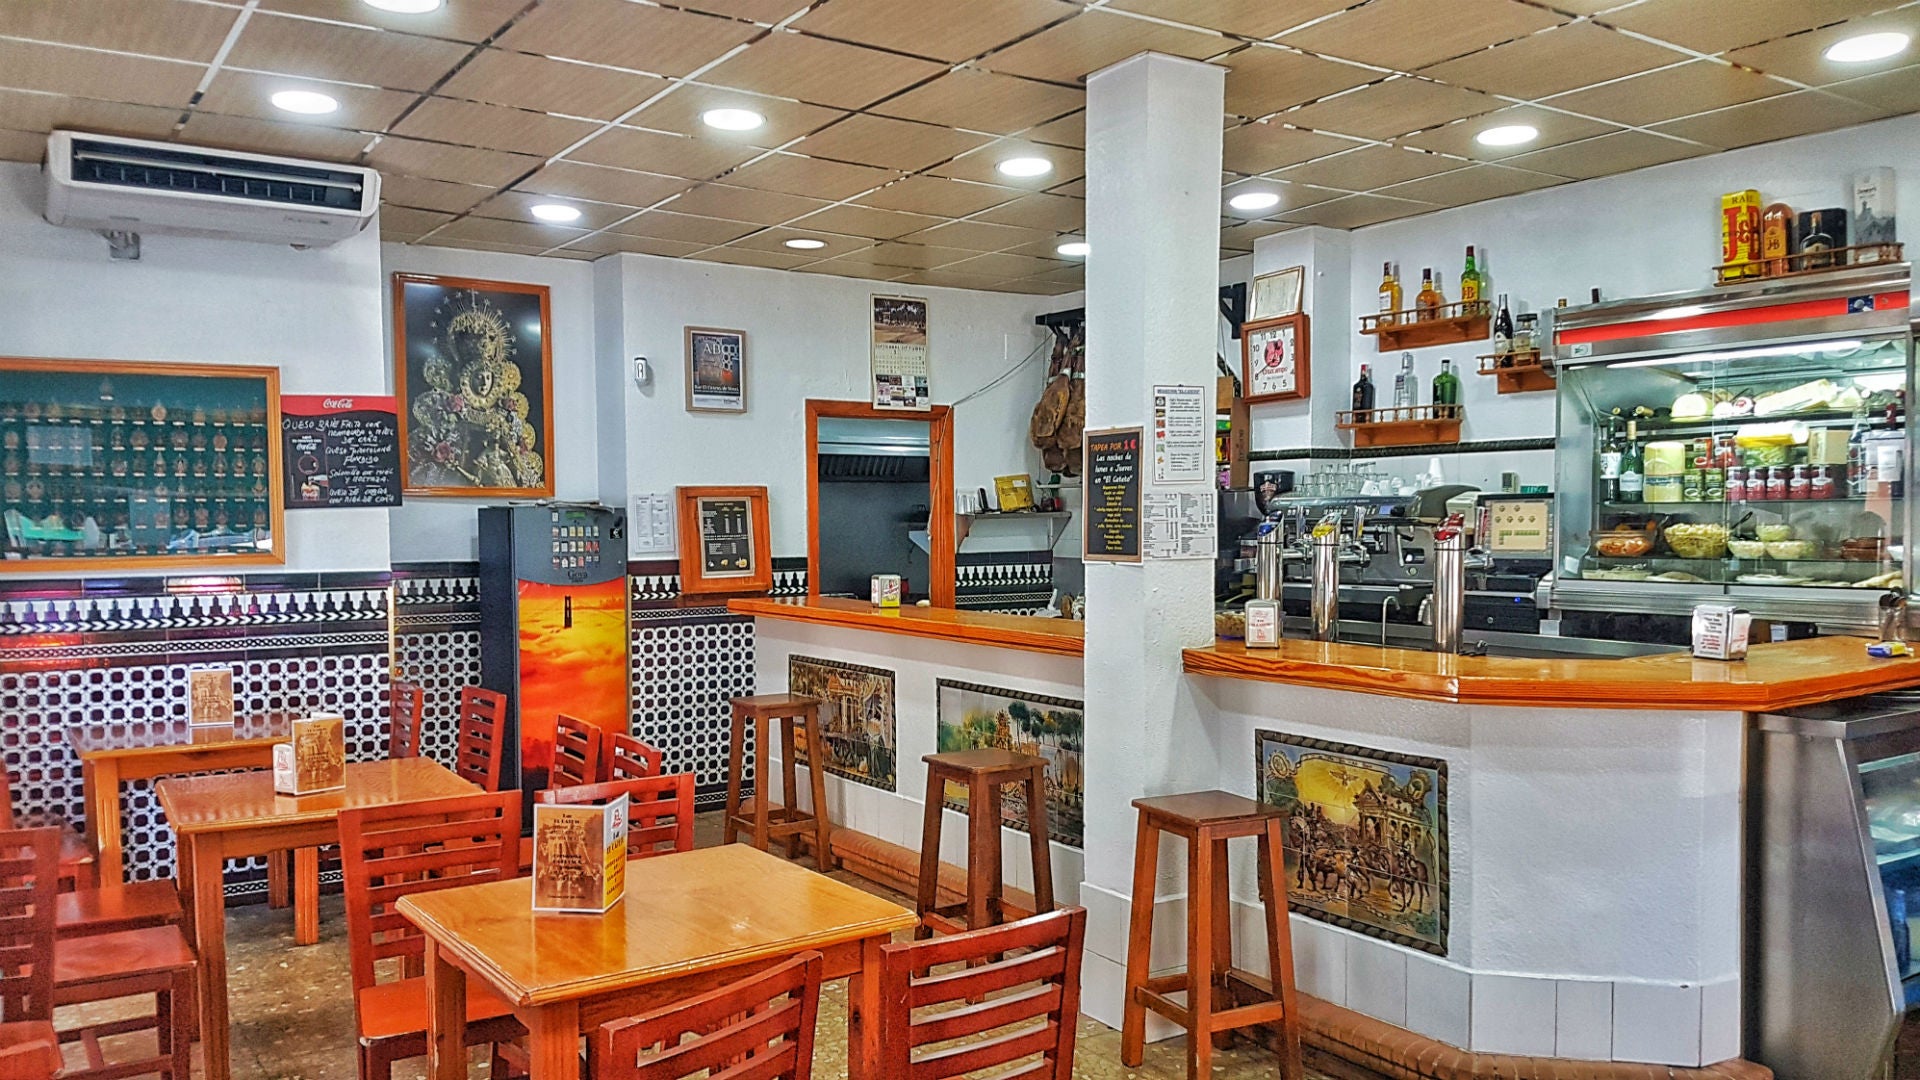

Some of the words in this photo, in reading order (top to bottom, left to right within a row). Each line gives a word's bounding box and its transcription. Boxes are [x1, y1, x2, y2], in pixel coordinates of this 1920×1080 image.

[1253, 344, 1259, 352] 10
[1272, 382, 1276, 390] 6
[282, 418, 315, 431] QUESO
[1106, 453, 1124, 461] noches
[1125, 451, 1132, 460] de
